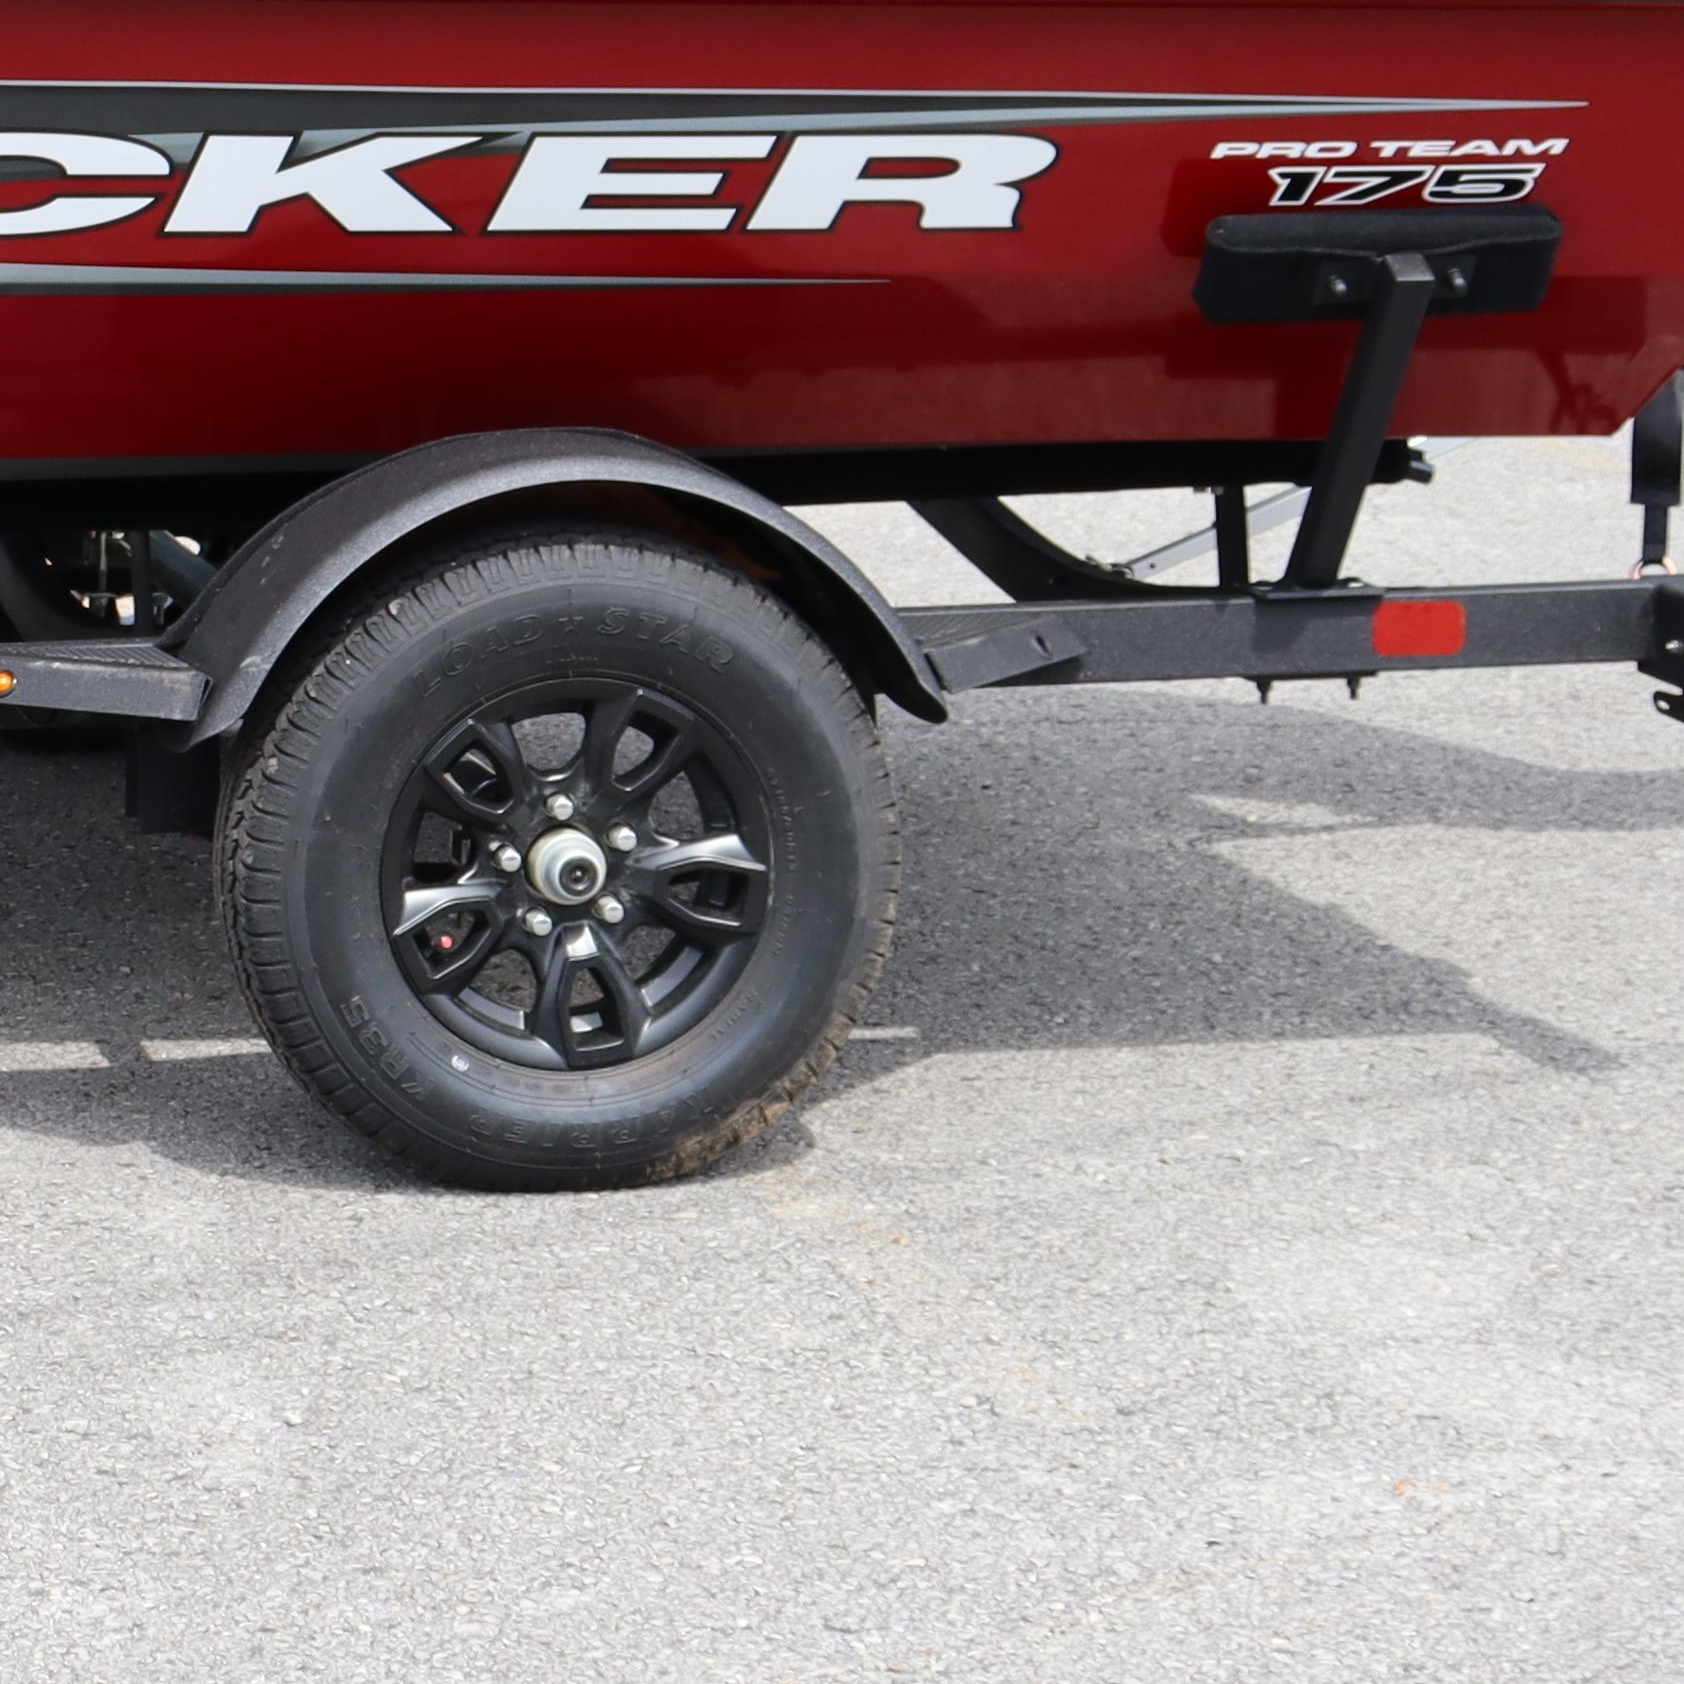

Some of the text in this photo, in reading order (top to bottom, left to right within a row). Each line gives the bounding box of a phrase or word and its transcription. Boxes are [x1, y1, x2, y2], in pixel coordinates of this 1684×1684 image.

[1209, 138, 1570, 159] PRO TEAM
[1267, 162, 1546, 206] 175
[414, 603, 735, 699] LOAD STAR
[338, 995, 434, 1103] KR35
